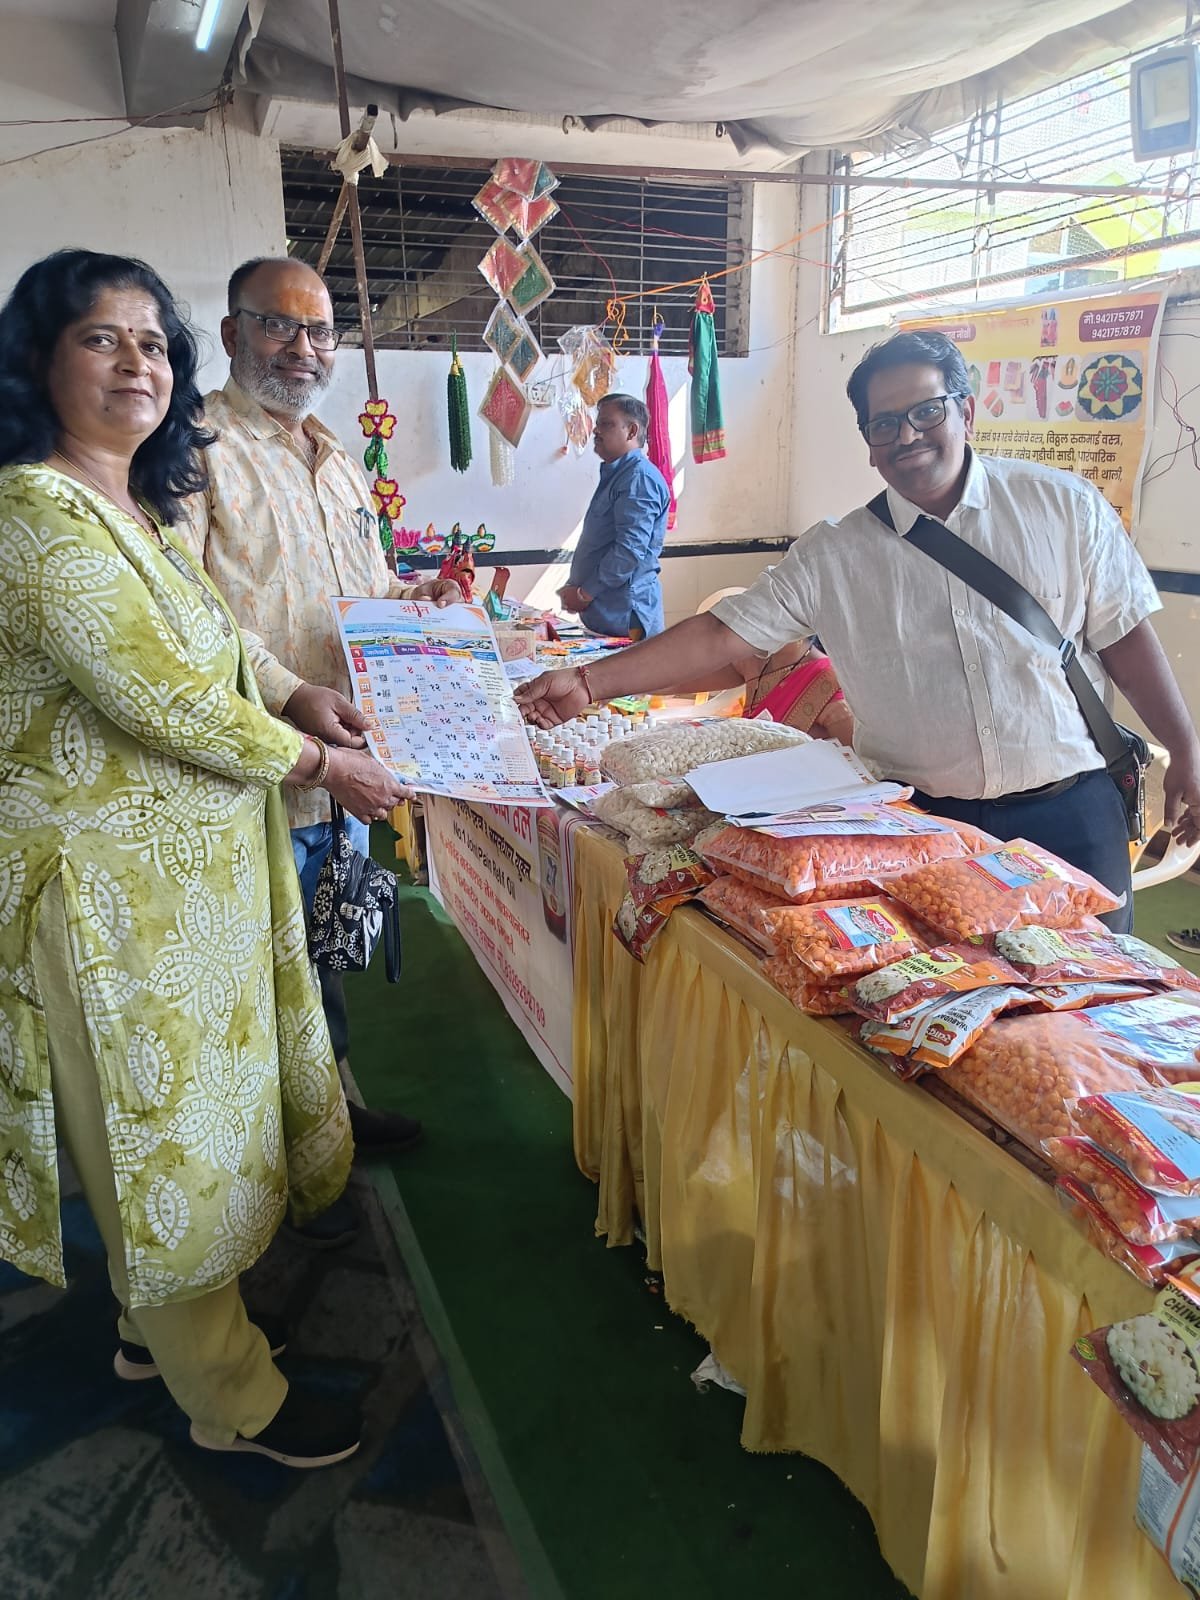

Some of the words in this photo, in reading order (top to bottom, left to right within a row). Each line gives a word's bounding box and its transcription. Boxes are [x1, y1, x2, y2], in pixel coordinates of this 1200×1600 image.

[1092, 325, 1142, 339] 9421757878
[1046, 430, 1069, 447] विठ्ठल
[1101, 433, 1123, 447] वस्त्र,
